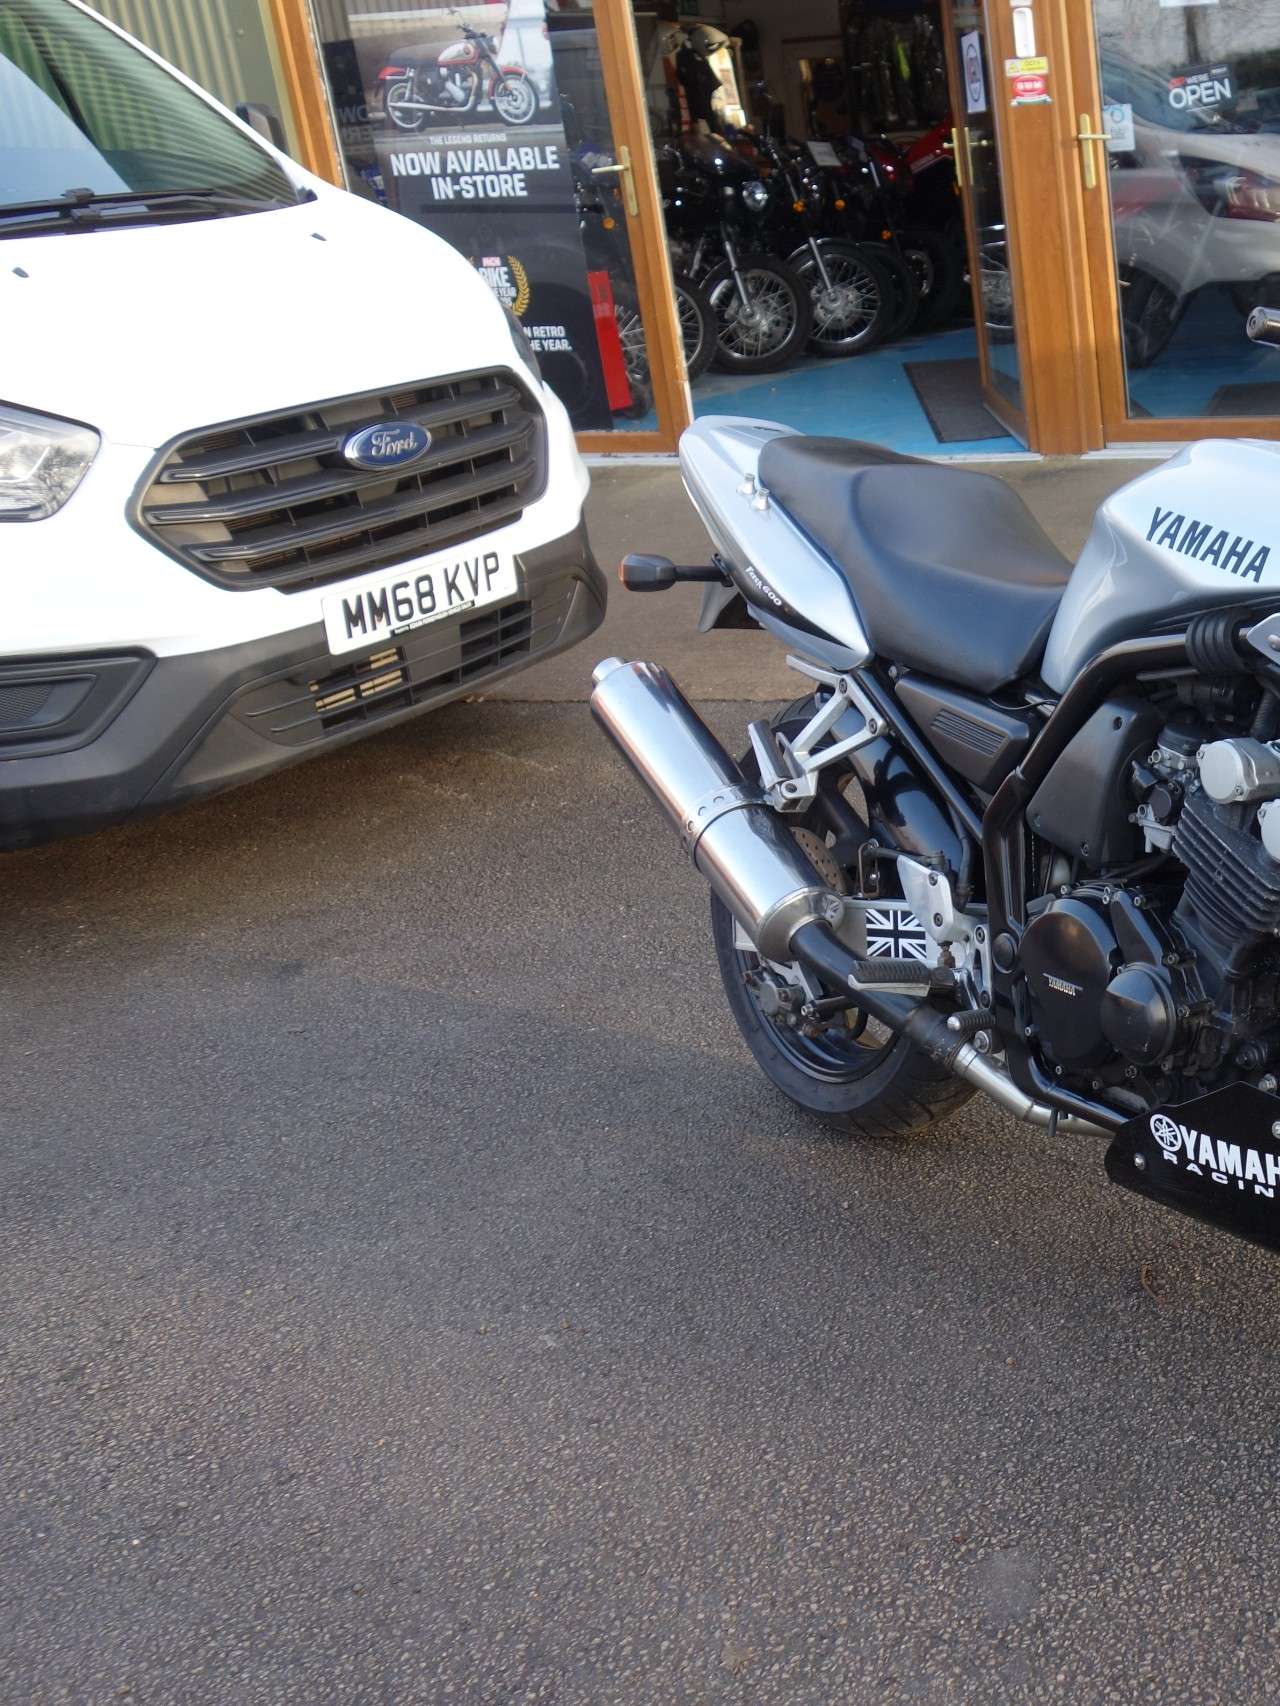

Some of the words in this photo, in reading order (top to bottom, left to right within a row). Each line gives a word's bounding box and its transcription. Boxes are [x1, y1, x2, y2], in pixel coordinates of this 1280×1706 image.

[1169, 78, 1232, 109] OPEN
[390, 151, 442, 176] NOW
[447, 145, 560, 174] AVAILABLE
[431, 173, 528, 200] IN-STORE
[533, 325, 566, 338] RETRO
[542, 339, 573, 352] YEAR.
[371, 428, 418, 456] Ford
[1145, 506, 1271, 583] YAMAHA
[341, 573, 437, 640] MM68
[443, 551, 500, 605] KVP
[762, 585, 782, 606] 600
